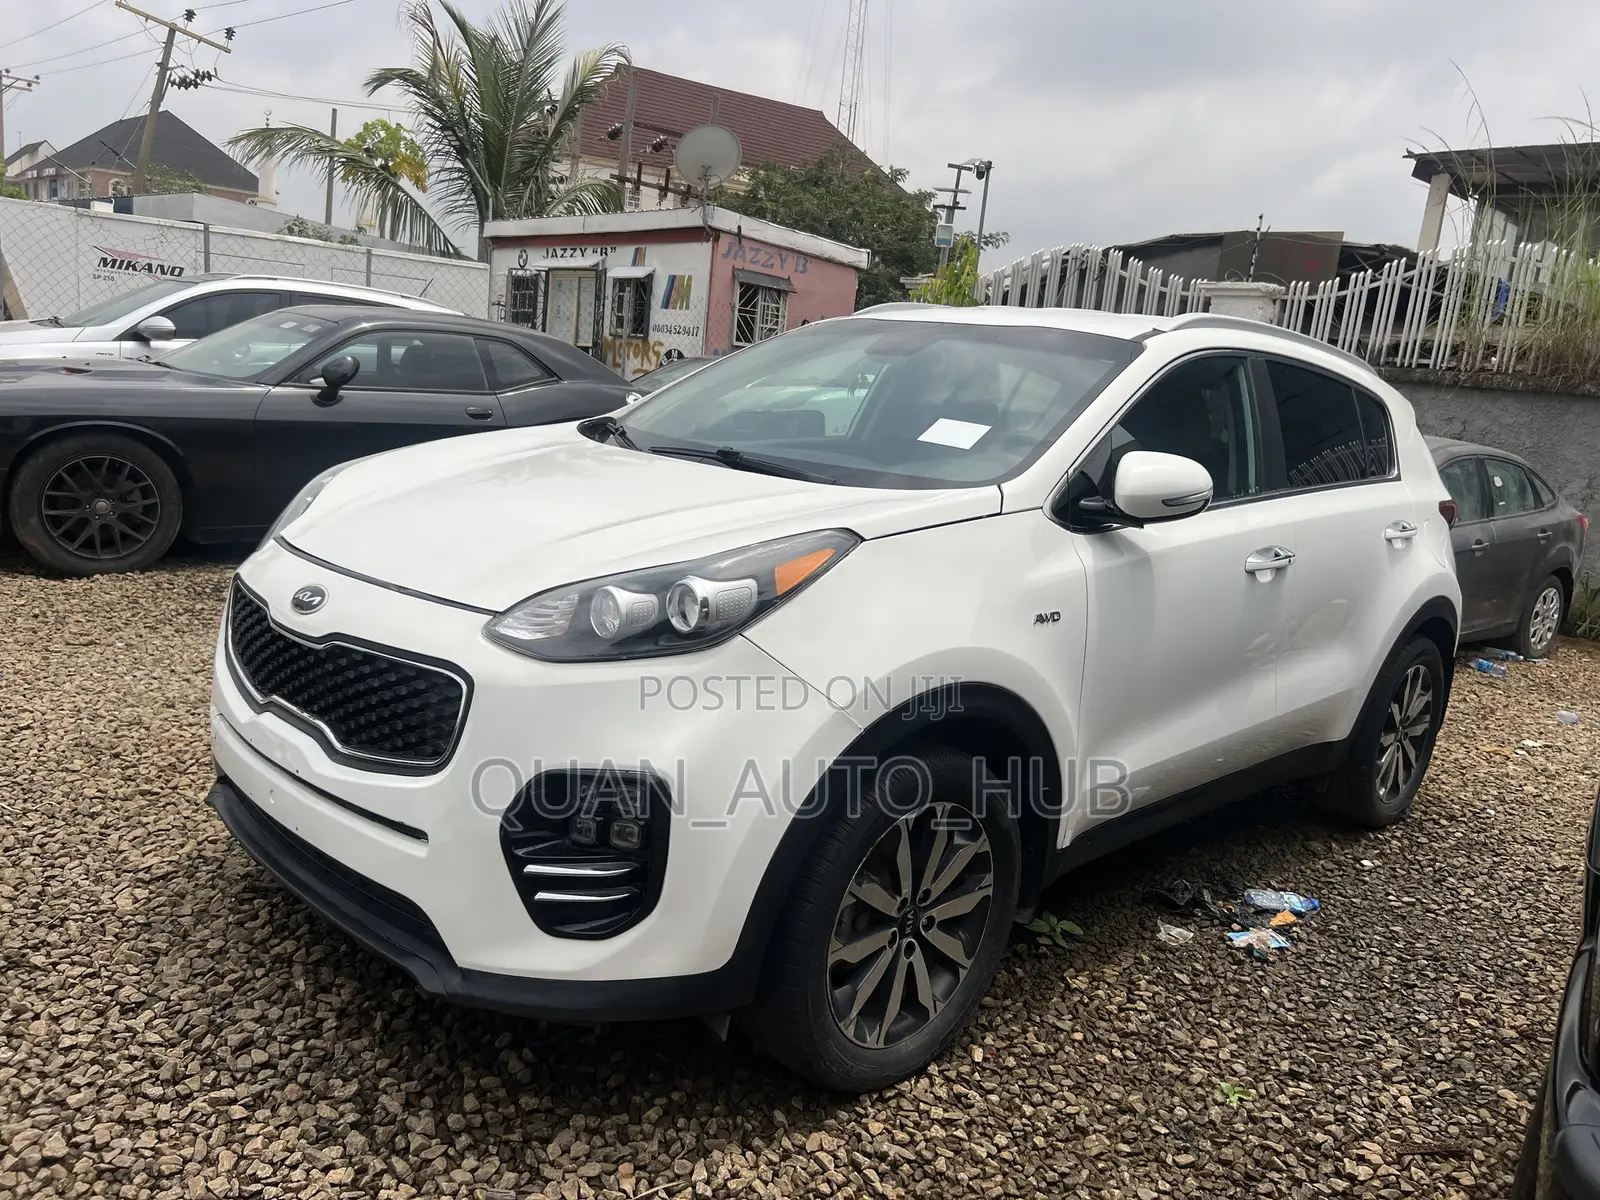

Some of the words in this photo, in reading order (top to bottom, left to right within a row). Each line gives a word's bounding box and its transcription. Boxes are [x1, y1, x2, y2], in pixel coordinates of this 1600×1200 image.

[543, 247, 588, 259] JAZZY
[721, 242, 788, 271] JAZZY
[97, 256, 185, 278] MIKANO
[652, 323, 700, 338] 08034529417
[1033, 611, 1061, 625] AWD
[904, 910, 915, 935] KIA
